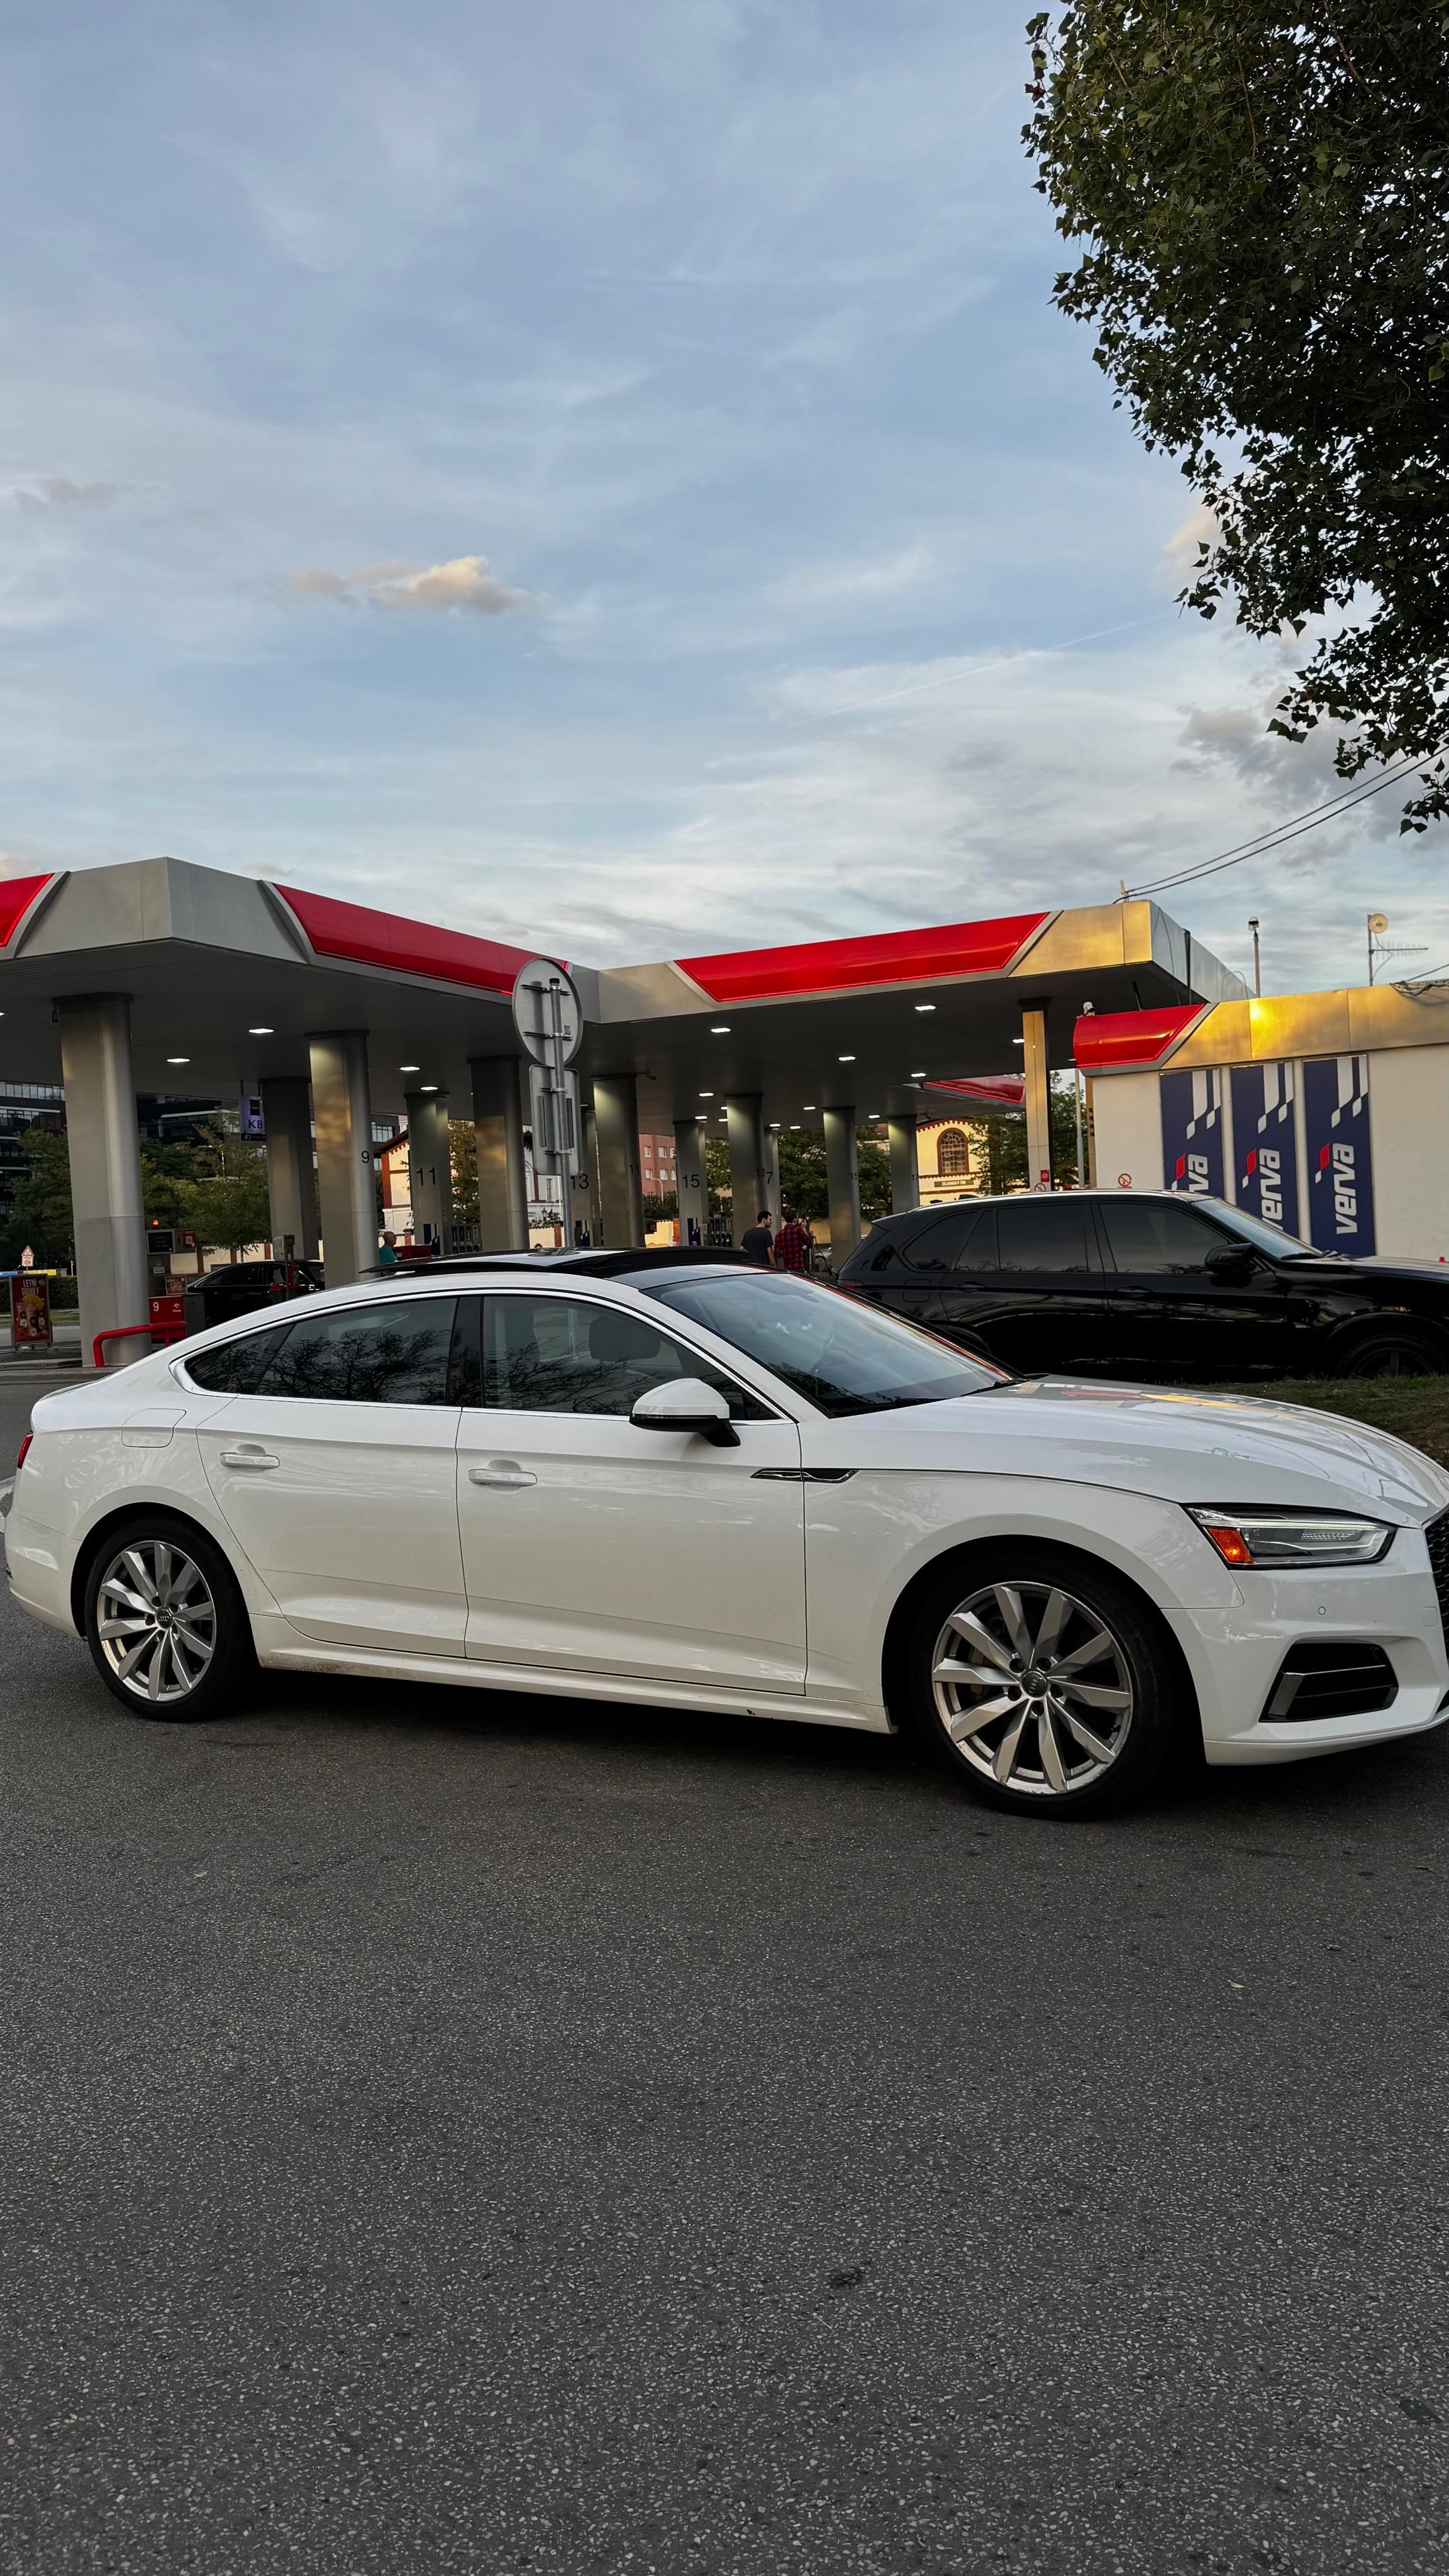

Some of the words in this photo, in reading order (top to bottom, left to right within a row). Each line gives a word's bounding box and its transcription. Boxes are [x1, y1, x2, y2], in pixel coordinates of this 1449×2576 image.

[248, 1119, 263, 1129] KB
[361, 1150, 370, 1163] 9
[416, 1167, 436, 1186] 11
[756, 1168, 766, 1177] 13
[570, 1173, 589, 1190] 13
[682, 1174, 700, 1189] 15
[1333, 1143, 1358, 1235] verva
[152, 1301, 160, 1312] 9
